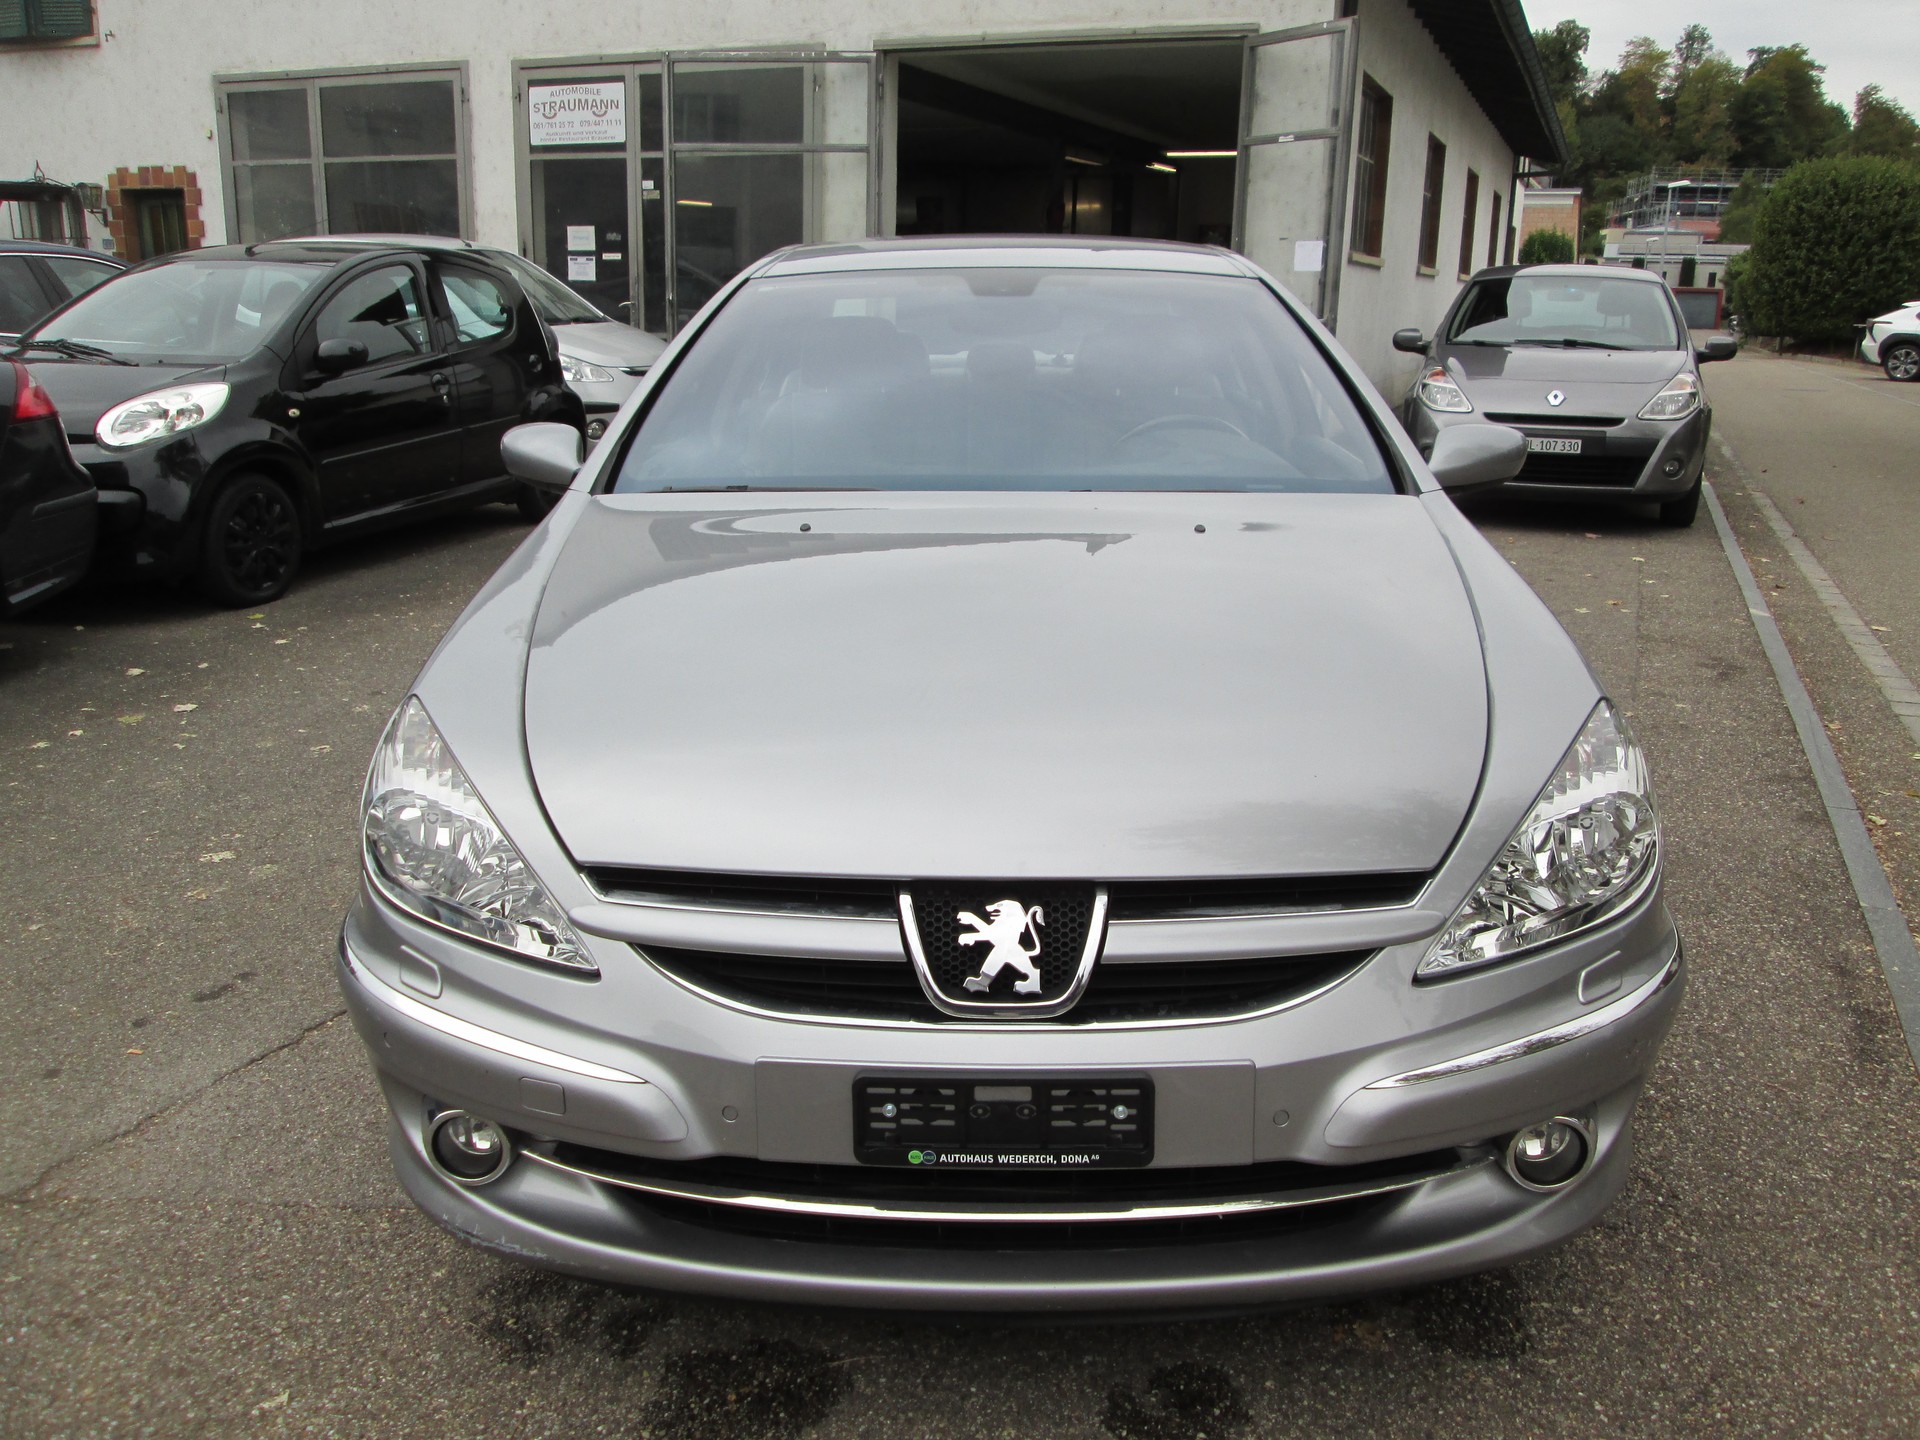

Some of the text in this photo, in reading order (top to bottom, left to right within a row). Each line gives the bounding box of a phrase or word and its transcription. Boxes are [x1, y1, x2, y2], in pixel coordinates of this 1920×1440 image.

[550, 86, 602, 98] AUTOMOBILE
[533, 98, 619, 113] STRAUMANN
[533, 122, 557, 130] 061/761
[579, 119, 604, 127] 079/447
[614, 118, 622, 126] 11
[939, 1153, 994, 1163] AUTOHAUS
[997, 1154, 1057, 1165] WEDERICH,
[1061, 1154, 1090, 1164] DONA
